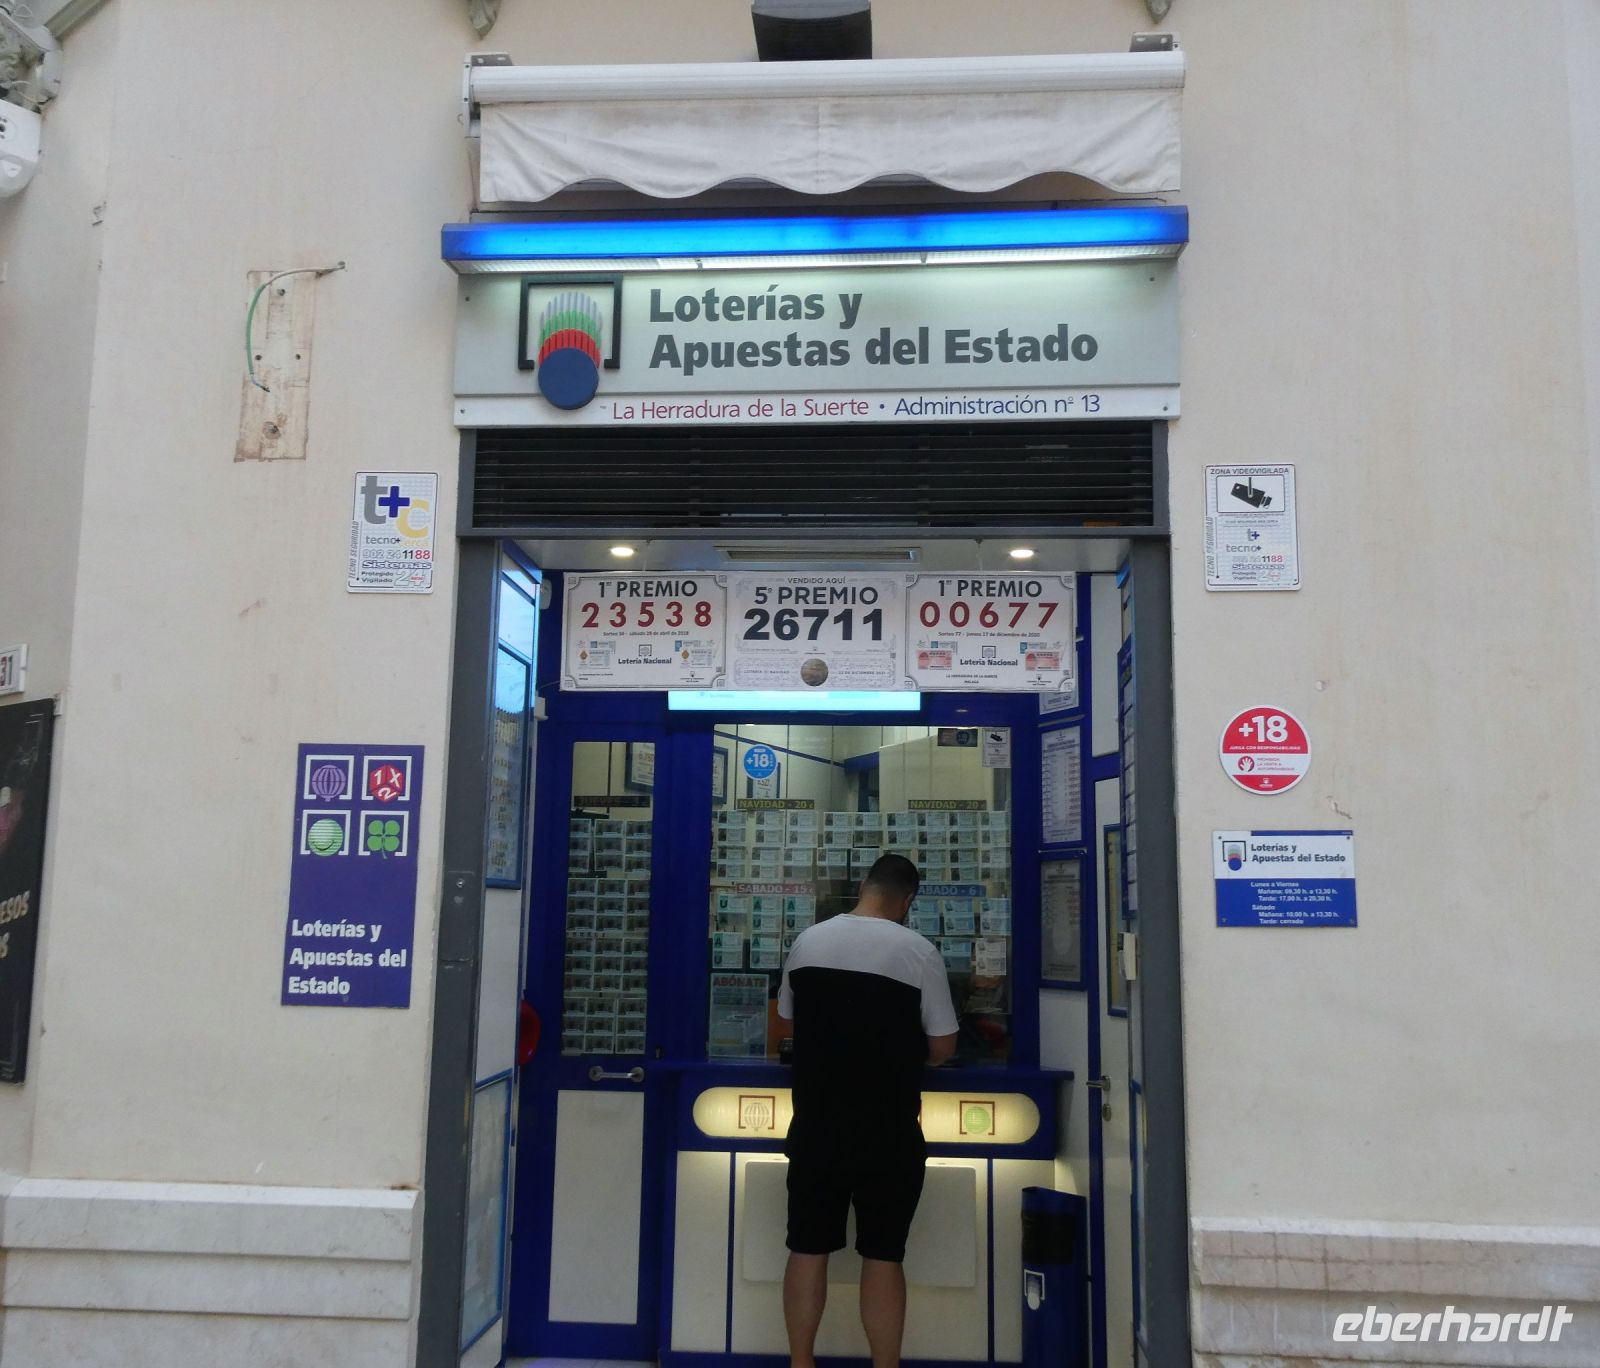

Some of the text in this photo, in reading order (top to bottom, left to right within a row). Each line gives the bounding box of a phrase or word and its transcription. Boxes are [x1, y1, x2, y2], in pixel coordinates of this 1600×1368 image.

[649, 284, 863, 329] Loterías y
[649, 323, 1098, 376] Apuestas del Estado
[612, 401, 634, 420] La
[642, 399, 741, 420] Herradura
[748, 398, 773, 418] de
[781, 397, 797, 417] la
[804, 398, 869, 417] Suerte
[894, 394, 1047, 416] Administración
[1081, 394, 1101, 413] 13
[1232, 467, 1289, 475] VIDEOVIGILADA
[361, 559, 432, 570] Sistemas
[616, 579, 697, 598] PREMIO
[826, 576, 847, 584] AQUÍ
[957, 579, 1043, 598] PREMIO
[778, 586, 878, 605] PREMIO
[581, 601, 712, 628] 23538
[743, 607, 883, 641] 26711
[919, 600, 1059, 629] 00677
[1238, 715, 1289, 743] +18
[746, 753, 769, 768] +18
[1251, 843, 1297, 853] Loterías y
[1252, 854, 1346, 864] Apuestas del Estado
[918, 886, 958, 894] ABADO
[291, 918, 382, 943] Loterías y
[289, 947, 407, 970] Apuestas del
[288, 976, 350, 995] Estado
